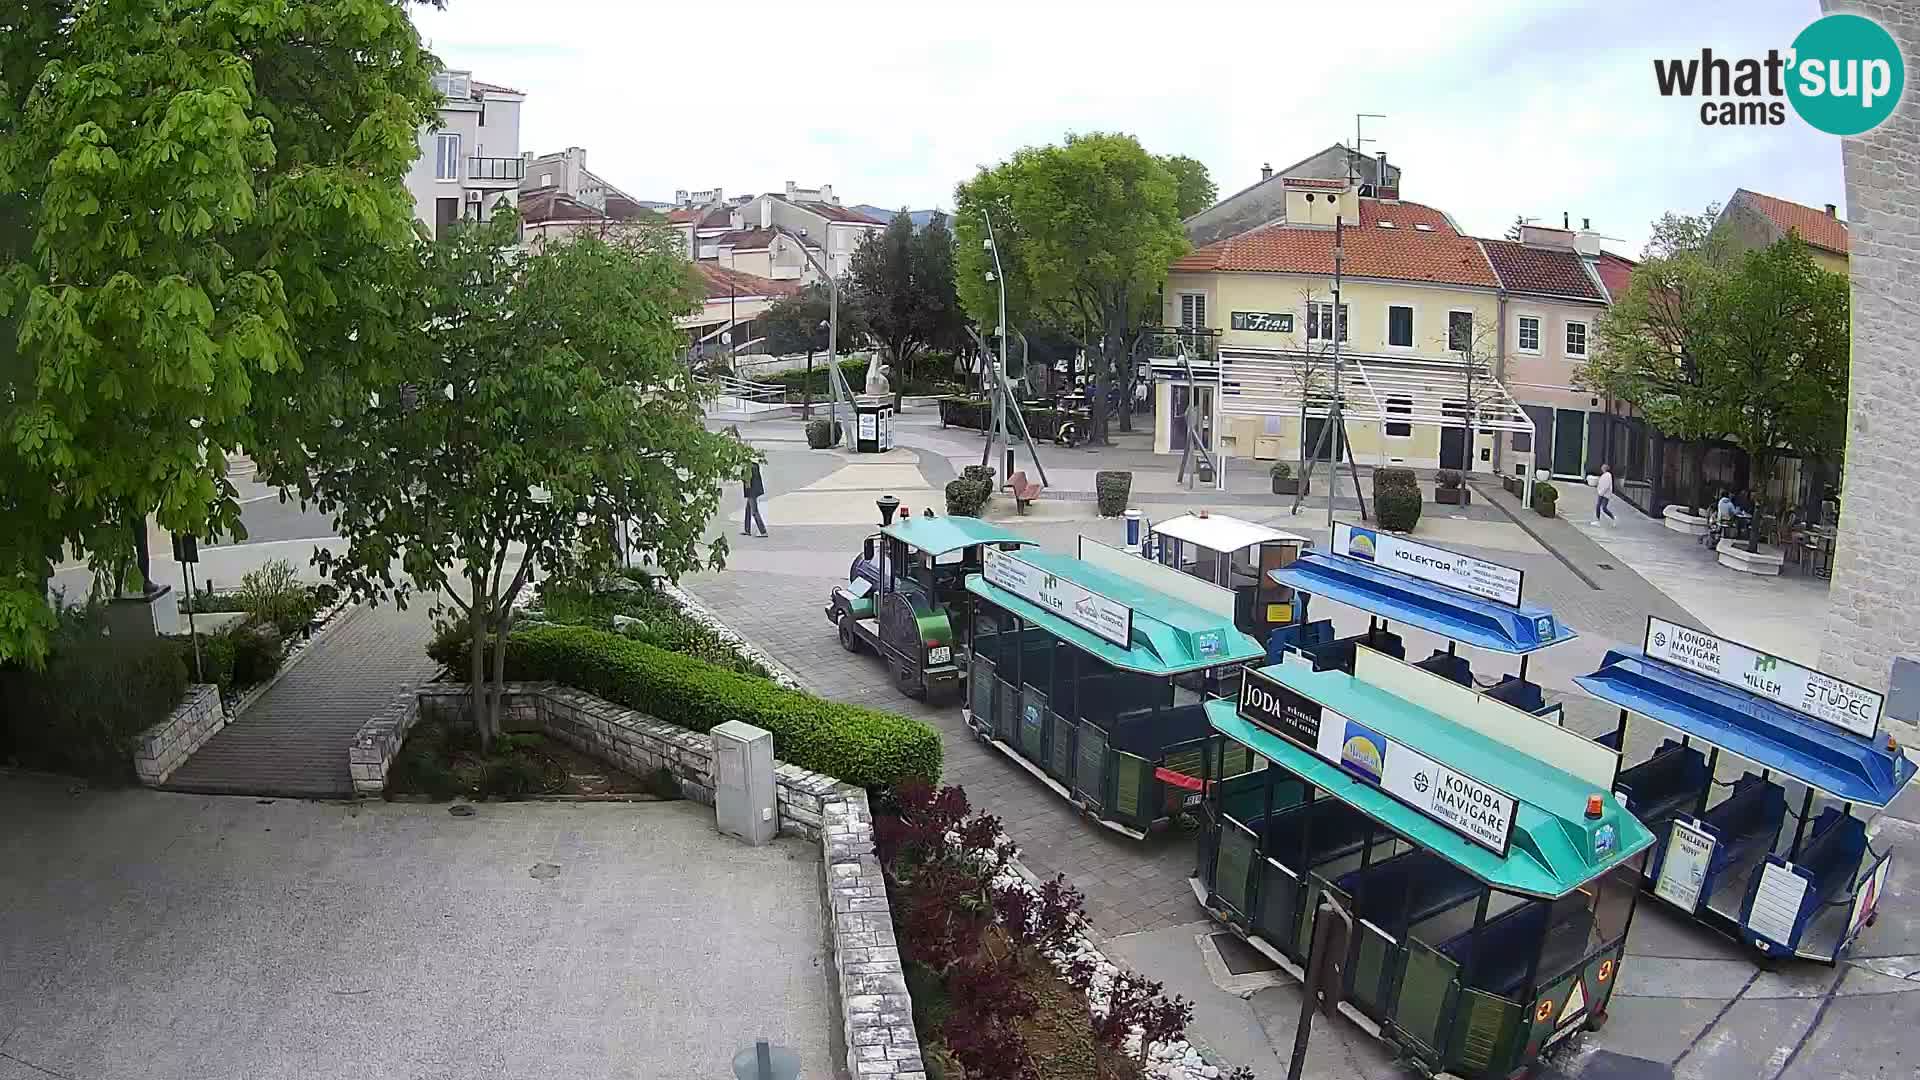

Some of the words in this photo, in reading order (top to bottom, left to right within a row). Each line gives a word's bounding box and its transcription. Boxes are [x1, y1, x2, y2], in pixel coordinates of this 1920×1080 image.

[1395, 549, 1451, 572] KOLEKTOR
[1038, 591, 1063, 611] MILLEM
[1671, 640, 1721, 666] NAVIGARE
[1678, 631, 1719, 652] KONOBA
[1743, 671, 1782, 696] MILLEM
[1244, 683, 1281, 718] JODA
[1805, 682, 1872, 720] STUDEC
[1445, 774, 1501, 815] KONOBA
[1436, 787, 1505, 833] NAVIGARE
